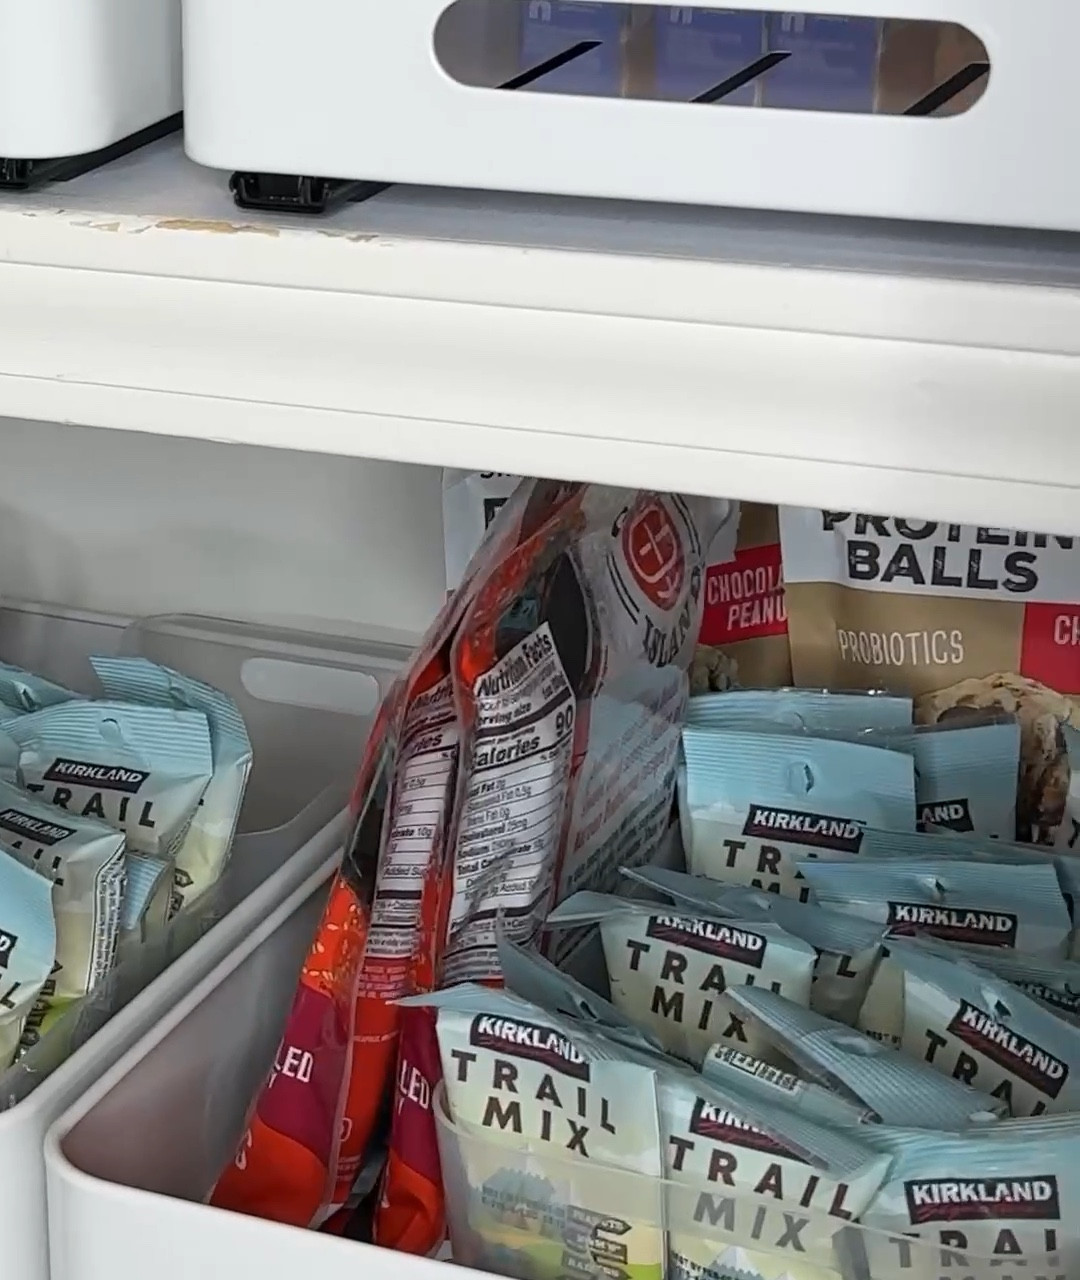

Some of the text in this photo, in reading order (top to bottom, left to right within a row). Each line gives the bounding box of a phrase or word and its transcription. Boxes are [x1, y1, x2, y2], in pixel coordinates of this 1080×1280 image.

[706, 563, 786, 607] CHOCOLA
[846, 538, 1040, 593] BALLS
[726, 598, 788, 632] PEANU
[837, 628, 965, 666] PROBIOTICS
[555, 705, 574, 738] 90
[56, 761, 144, 784] KIRKLAND
[753, 809, 862, 840] KIRKLAND
[894, 904, 1013, 933] KIRKLAND
[650, 985, 749, 1044] MIX
[477, 1015, 592, 1065] KIRKLAND
[962, 1004, 1064, 1080] KIRKLAND
[450, 1048, 617, 1136] TRAIL
[481, 1095, 590, 1159] MIX
[669, 1134, 853, 1221] TRAIL
[911, 1180, 1053, 1206] KIRKLAND
[693, 1190, 811, 1253] MIX
[887, 1227, 1061, 1269] TRAI
